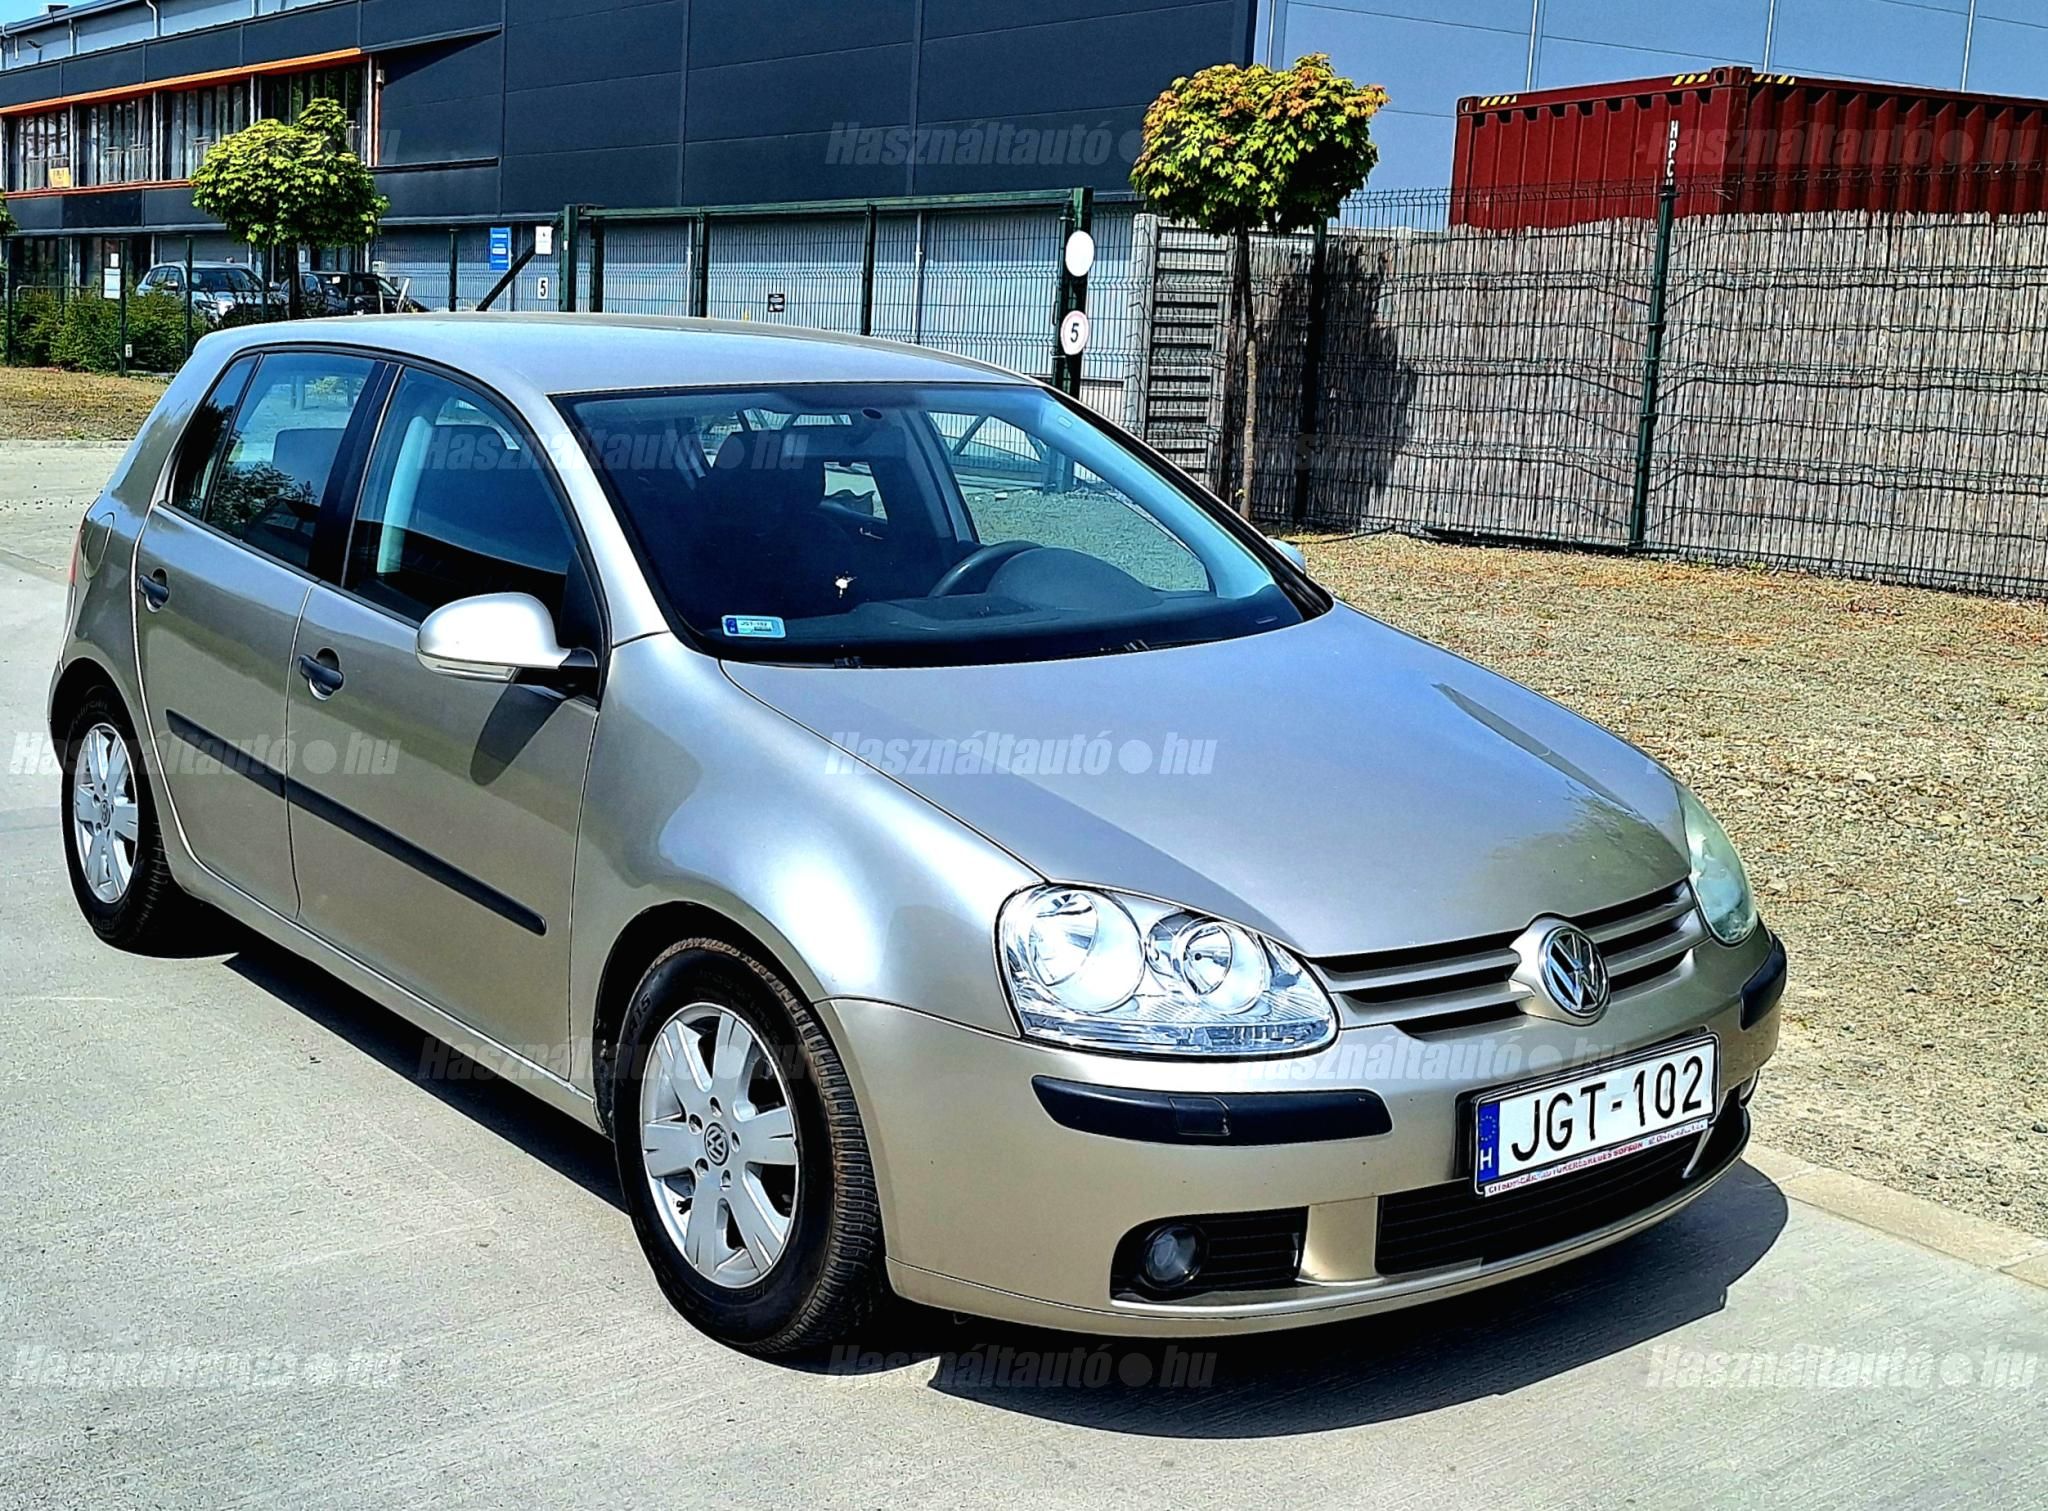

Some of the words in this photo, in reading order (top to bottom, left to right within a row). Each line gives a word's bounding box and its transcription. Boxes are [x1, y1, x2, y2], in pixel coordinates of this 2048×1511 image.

[540, 280, 546, 297] 5
[1070, 323, 1079, 343] 5
[1511, 1056, 1703, 1162] JGT-102
[1479, 1148, 1493, 1170] H
